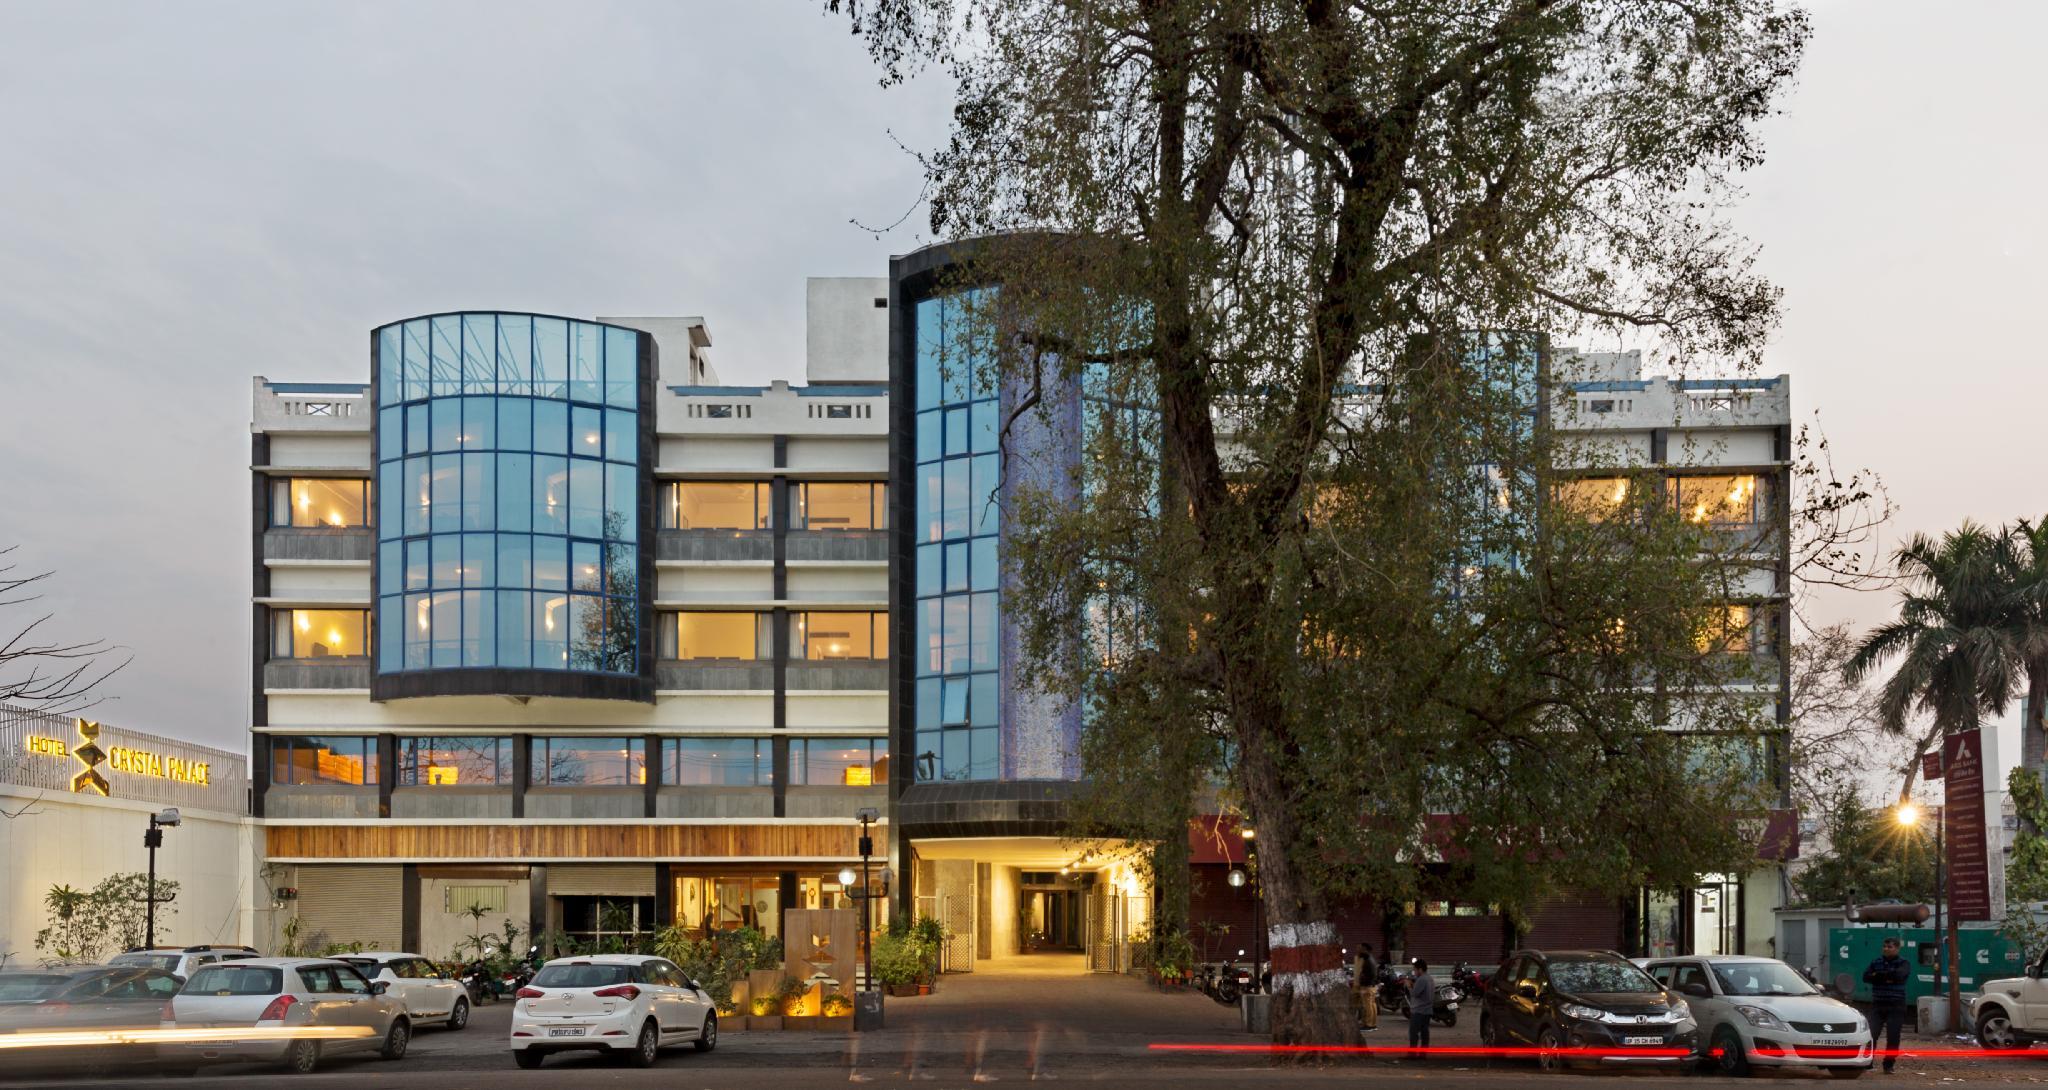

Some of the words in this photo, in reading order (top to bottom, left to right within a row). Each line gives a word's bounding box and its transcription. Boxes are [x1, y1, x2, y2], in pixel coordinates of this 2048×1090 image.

[29, 736, 70, 756] HOTEL
[109, 746, 165, 777] CRYSTAL
[168, 757, 211, 785] PALACE
